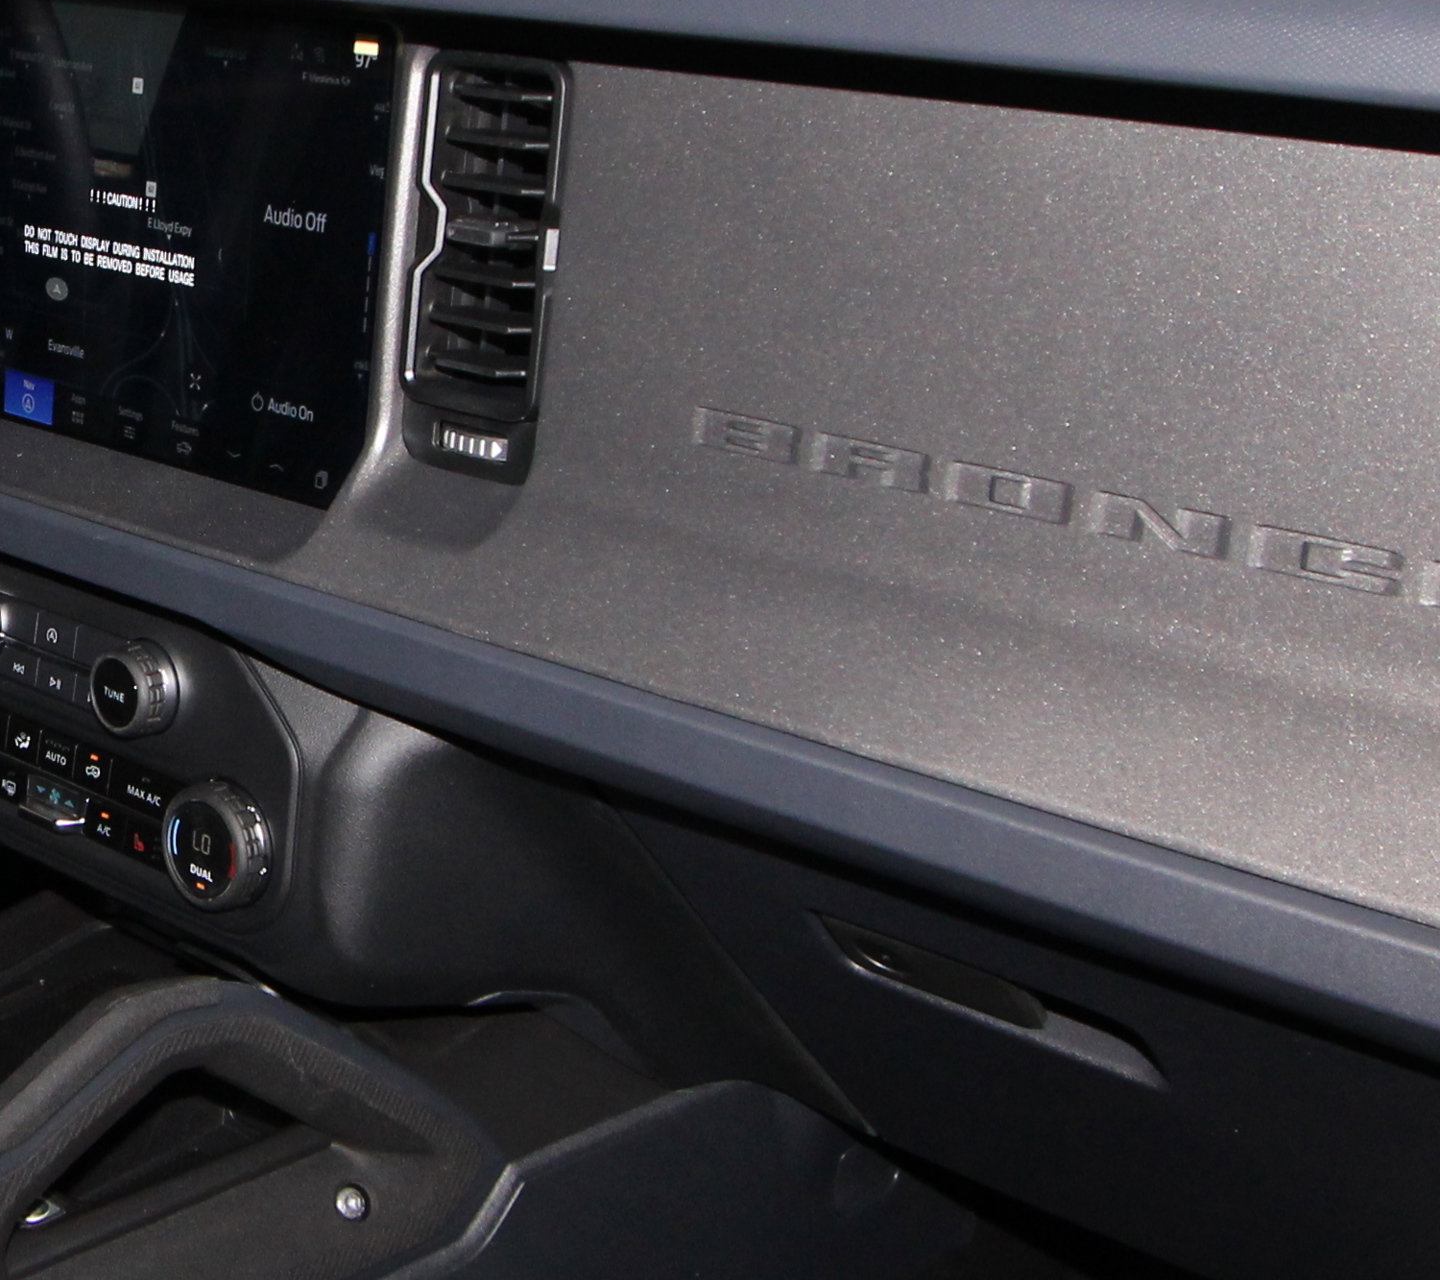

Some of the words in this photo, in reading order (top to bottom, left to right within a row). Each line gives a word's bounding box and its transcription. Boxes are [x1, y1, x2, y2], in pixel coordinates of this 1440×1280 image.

[153, 218, 174, 234] Lloyd
[174, 221, 193, 238] Expy
[263, 204, 303, 229] Audio
[304, 211, 328, 234] Off
[23, 224, 36, 238] DO
[37, 227, 52, 241] NOT
[54, 229, 79, 247] TOUCH
[80, 234, 111, 253] DISPLAY
[112, 241, 141, 259] DURING
[142, 247, 195, 270] INSTALLATION
[24, 240, 40, 255] THIS
[42, 243, 59, 259] FILM
[60, 247, 69, 261] IS
[70, 249, 82, 264] TO
[83, 251, 95, 266] BE
[96, 254, 133, 275] REMOVED
[135, 262, 166, 281] BEFORE
[167, 268, 196, 287] USAGE
[47, 339, 85, 359] Evansville
[267, 397, 298, 418] Audio
[298, 405, 314, 422] On
[104, 686, 125, 703] TUNE
[45, 750, 67, 766] AUTO
[127, 784, 146, 801] MAX
[146, 794, 162, 808] A/C
[97, 824, 111, 837] A/C
[193, 830, 211, 856] LO
[190, 863, 213, 883] DUAL
